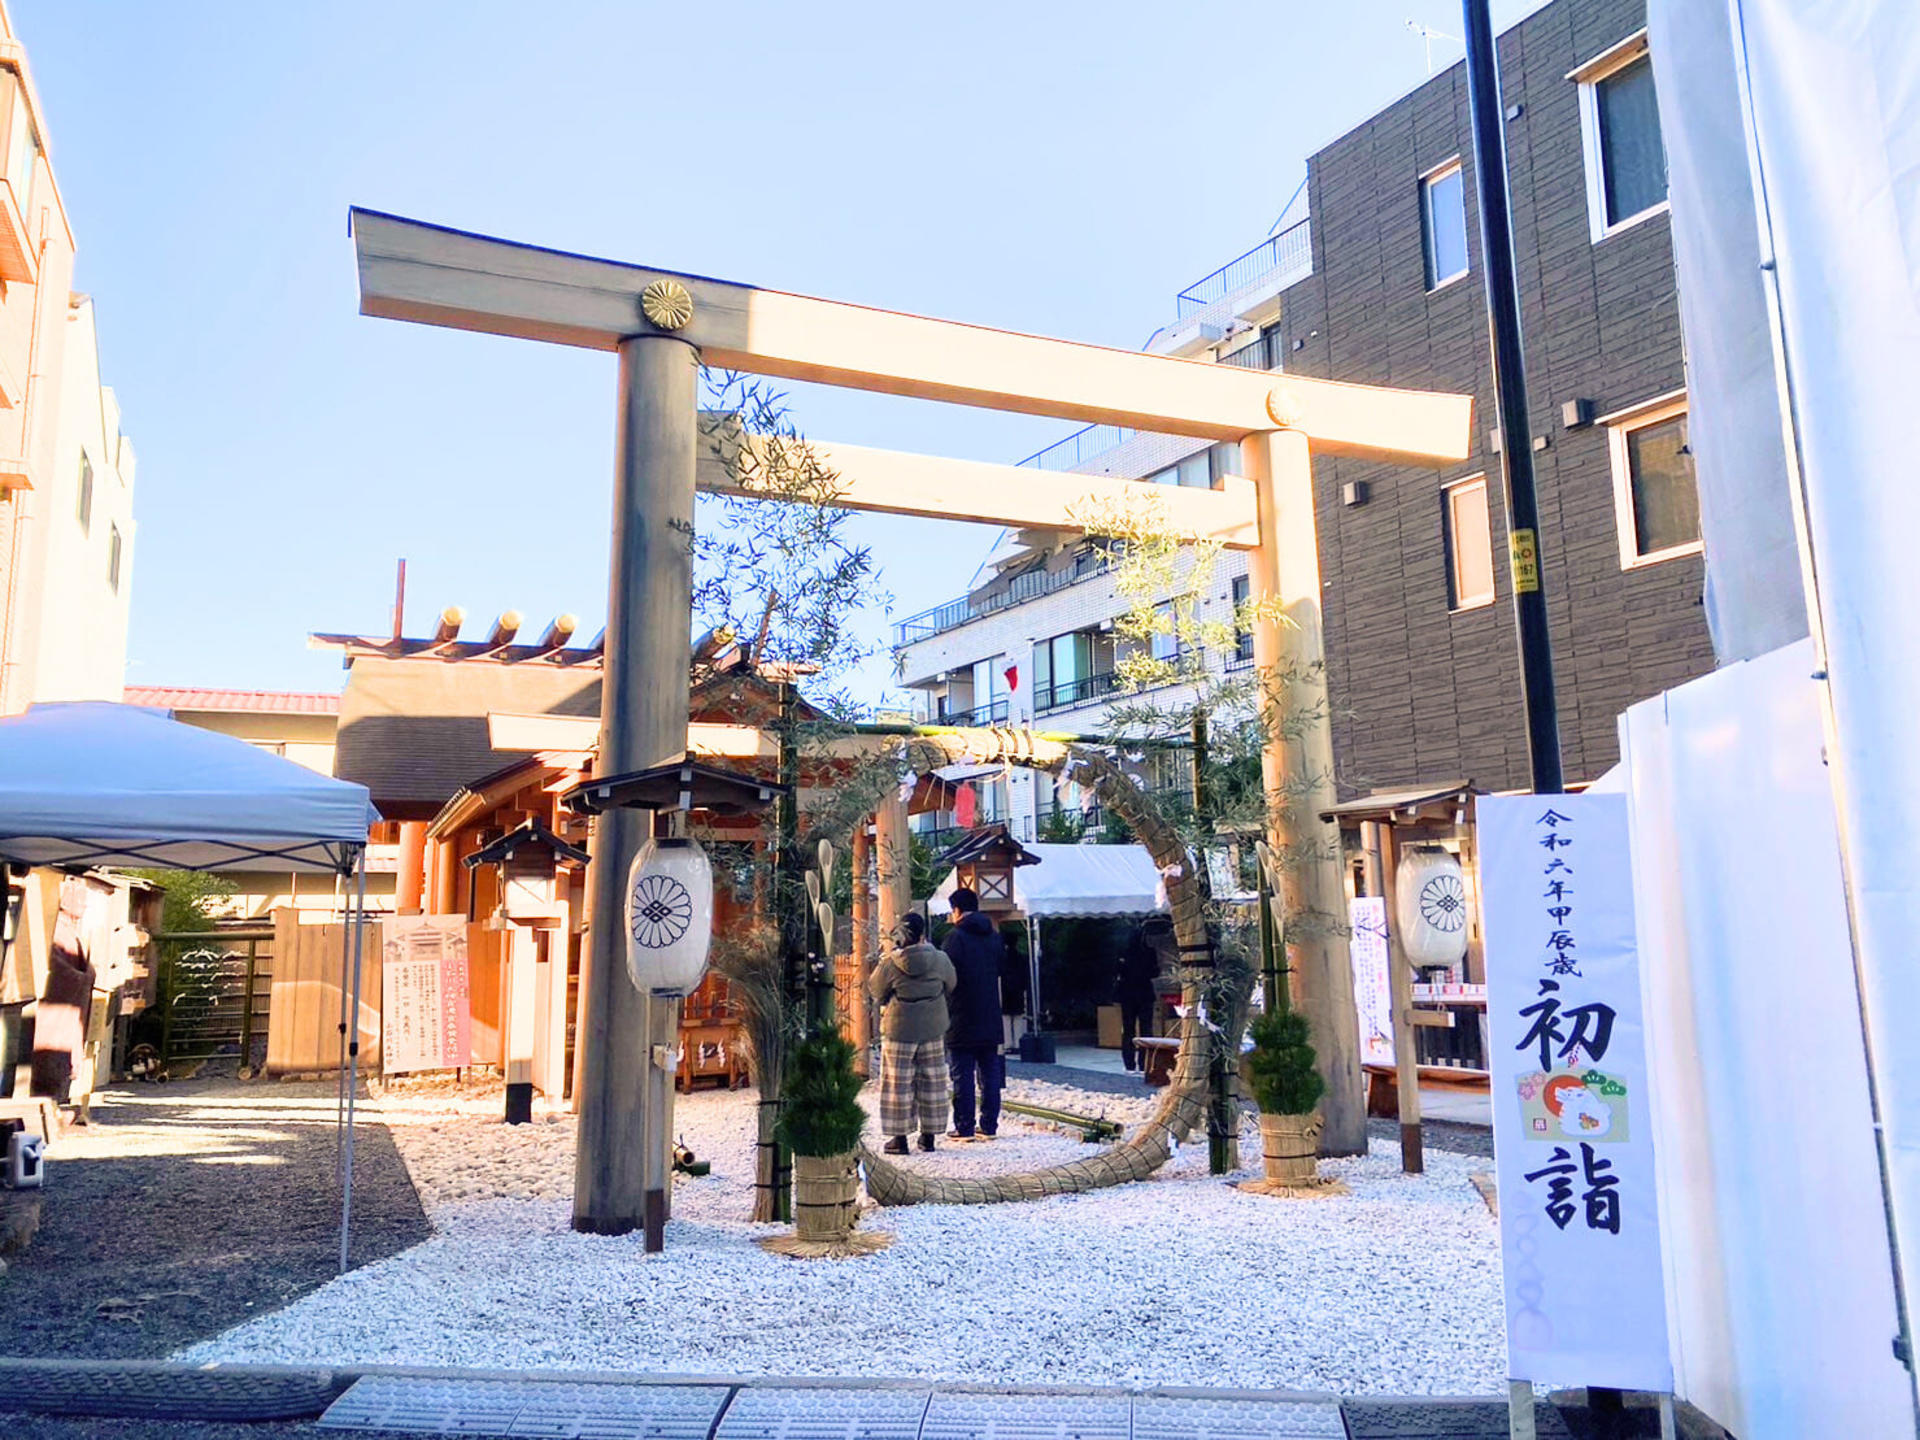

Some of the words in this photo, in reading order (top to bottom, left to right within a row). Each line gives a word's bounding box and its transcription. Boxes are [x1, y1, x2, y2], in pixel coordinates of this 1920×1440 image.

[1537, 809, 1582, 978] 令和六年甲辰歳
